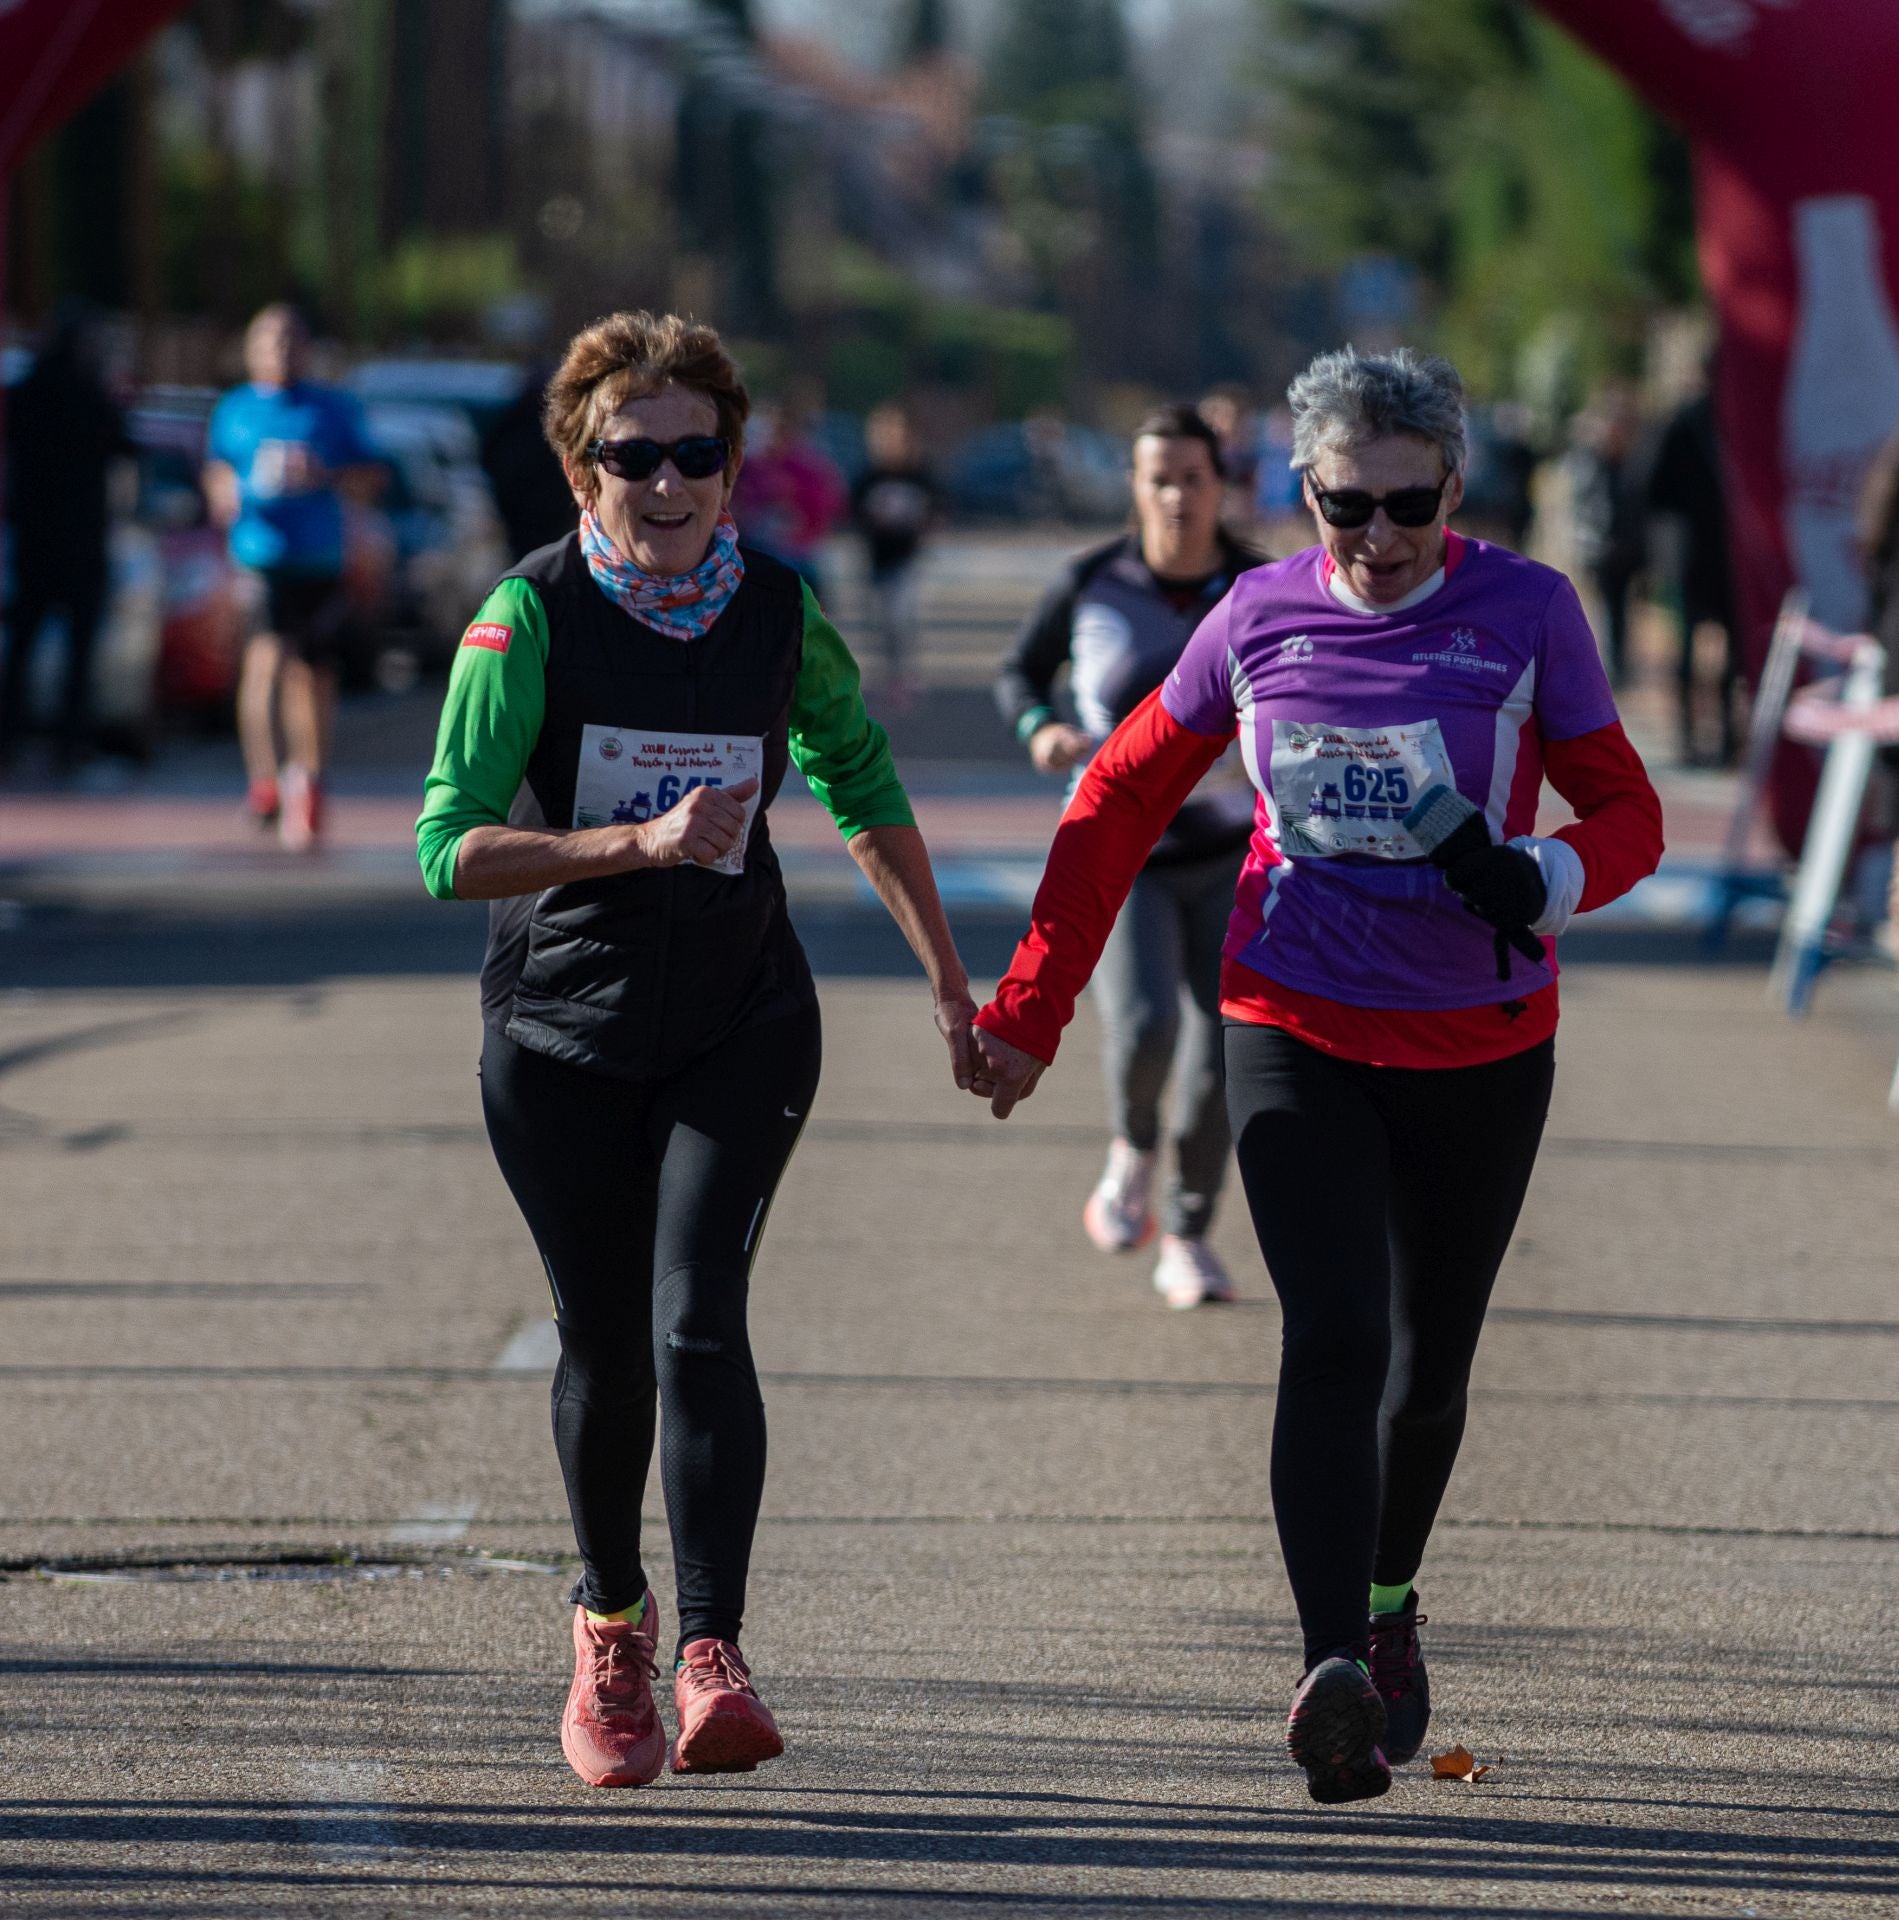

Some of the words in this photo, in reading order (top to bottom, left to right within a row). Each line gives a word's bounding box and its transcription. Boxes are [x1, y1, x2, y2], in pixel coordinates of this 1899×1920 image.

[1412, 652, 1452, 663] ATLETAS
[1453, 655, 1508, 673] POPULARES
[703, 742, 714, 754] del
[665, 761, 672, 771] y
[674, 756, 687, 767] del
[657, 775, 722, 812] 64
[1344, 764, 1409, 804] 625
